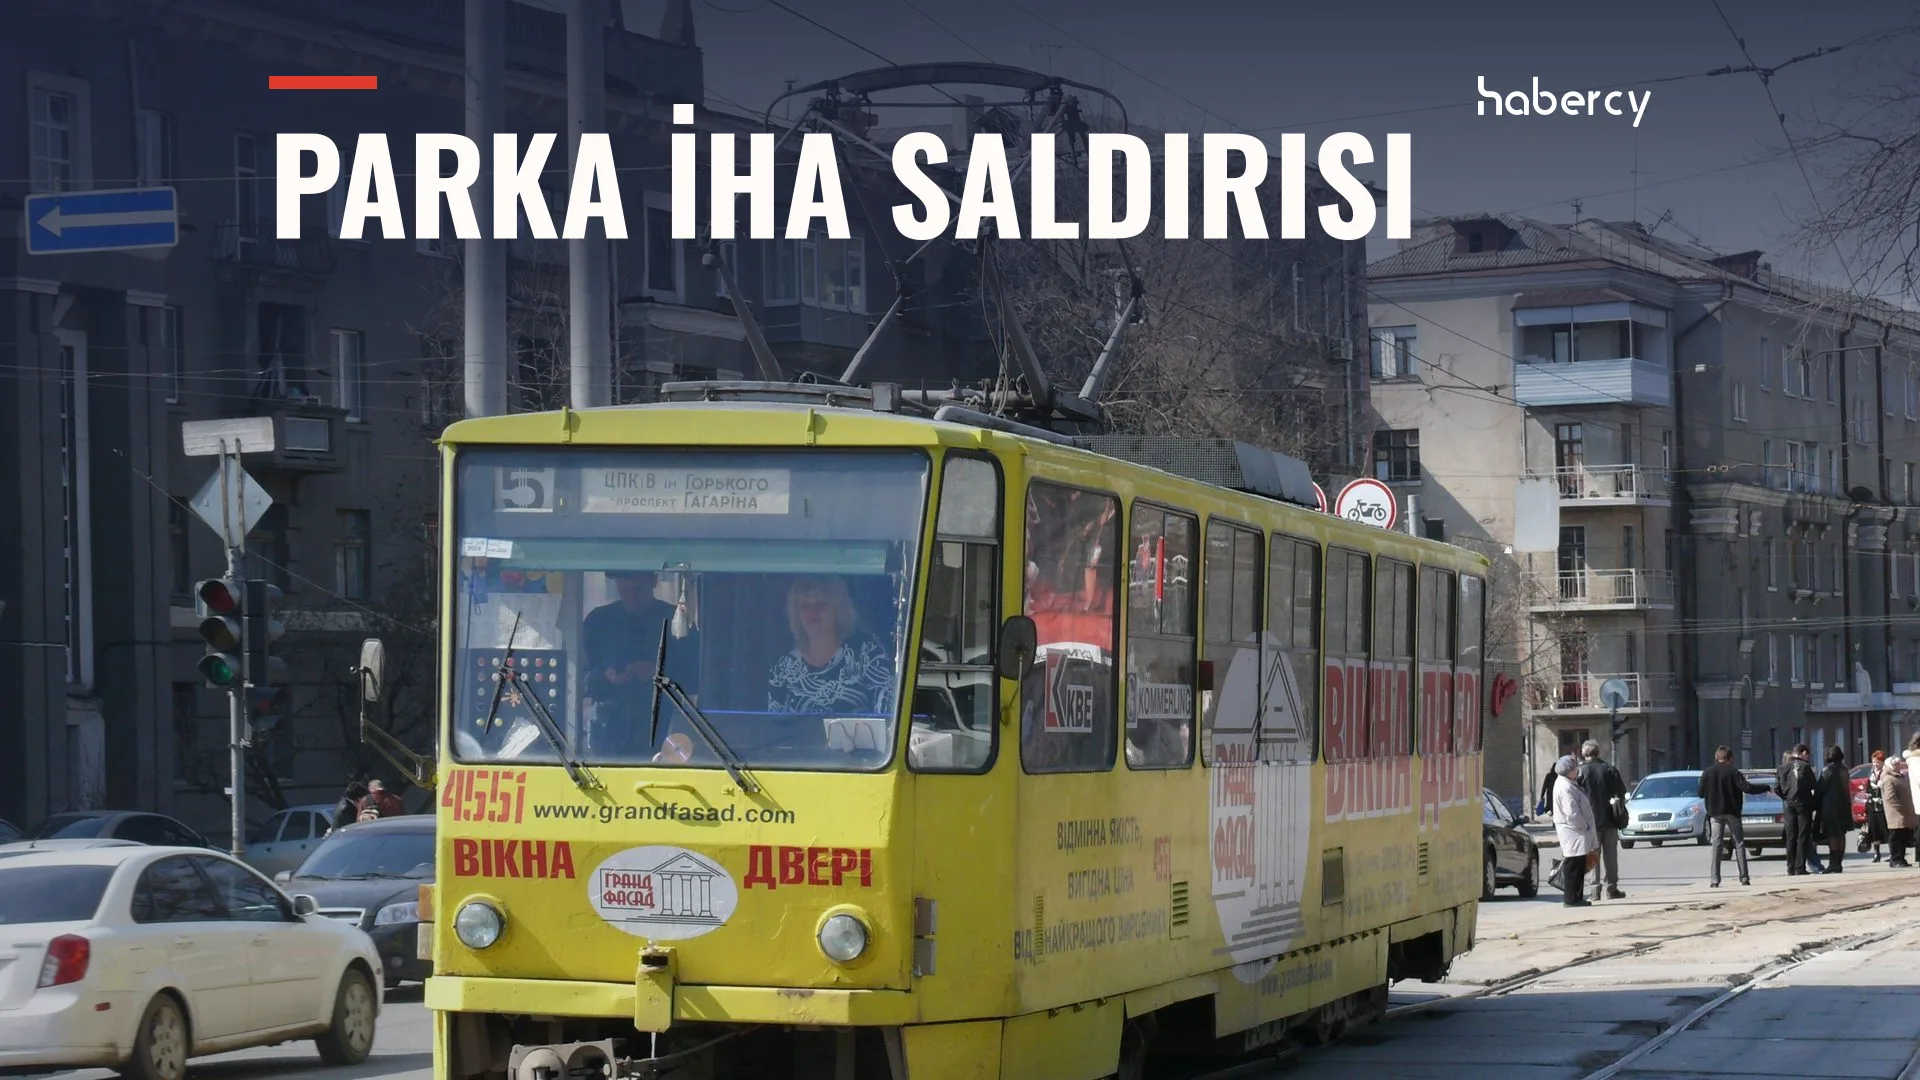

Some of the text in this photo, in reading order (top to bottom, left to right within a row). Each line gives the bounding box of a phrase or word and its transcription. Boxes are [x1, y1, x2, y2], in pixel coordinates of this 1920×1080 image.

[502, 467, 544, 508] 5
[1066, 688, 1092, 728] KBE
[442, 769, 526, 824] 4551
[534, 802, 795, 824] www.grandfasad.com
[1057, 818, 1107, 853] ВІДМІННА
[453, 838, 872, 890] ВІКНА ДВЕРІ
[604, 872, 653, 891] ГРАНД
[602, 890, 656, 909] ФАСАД
